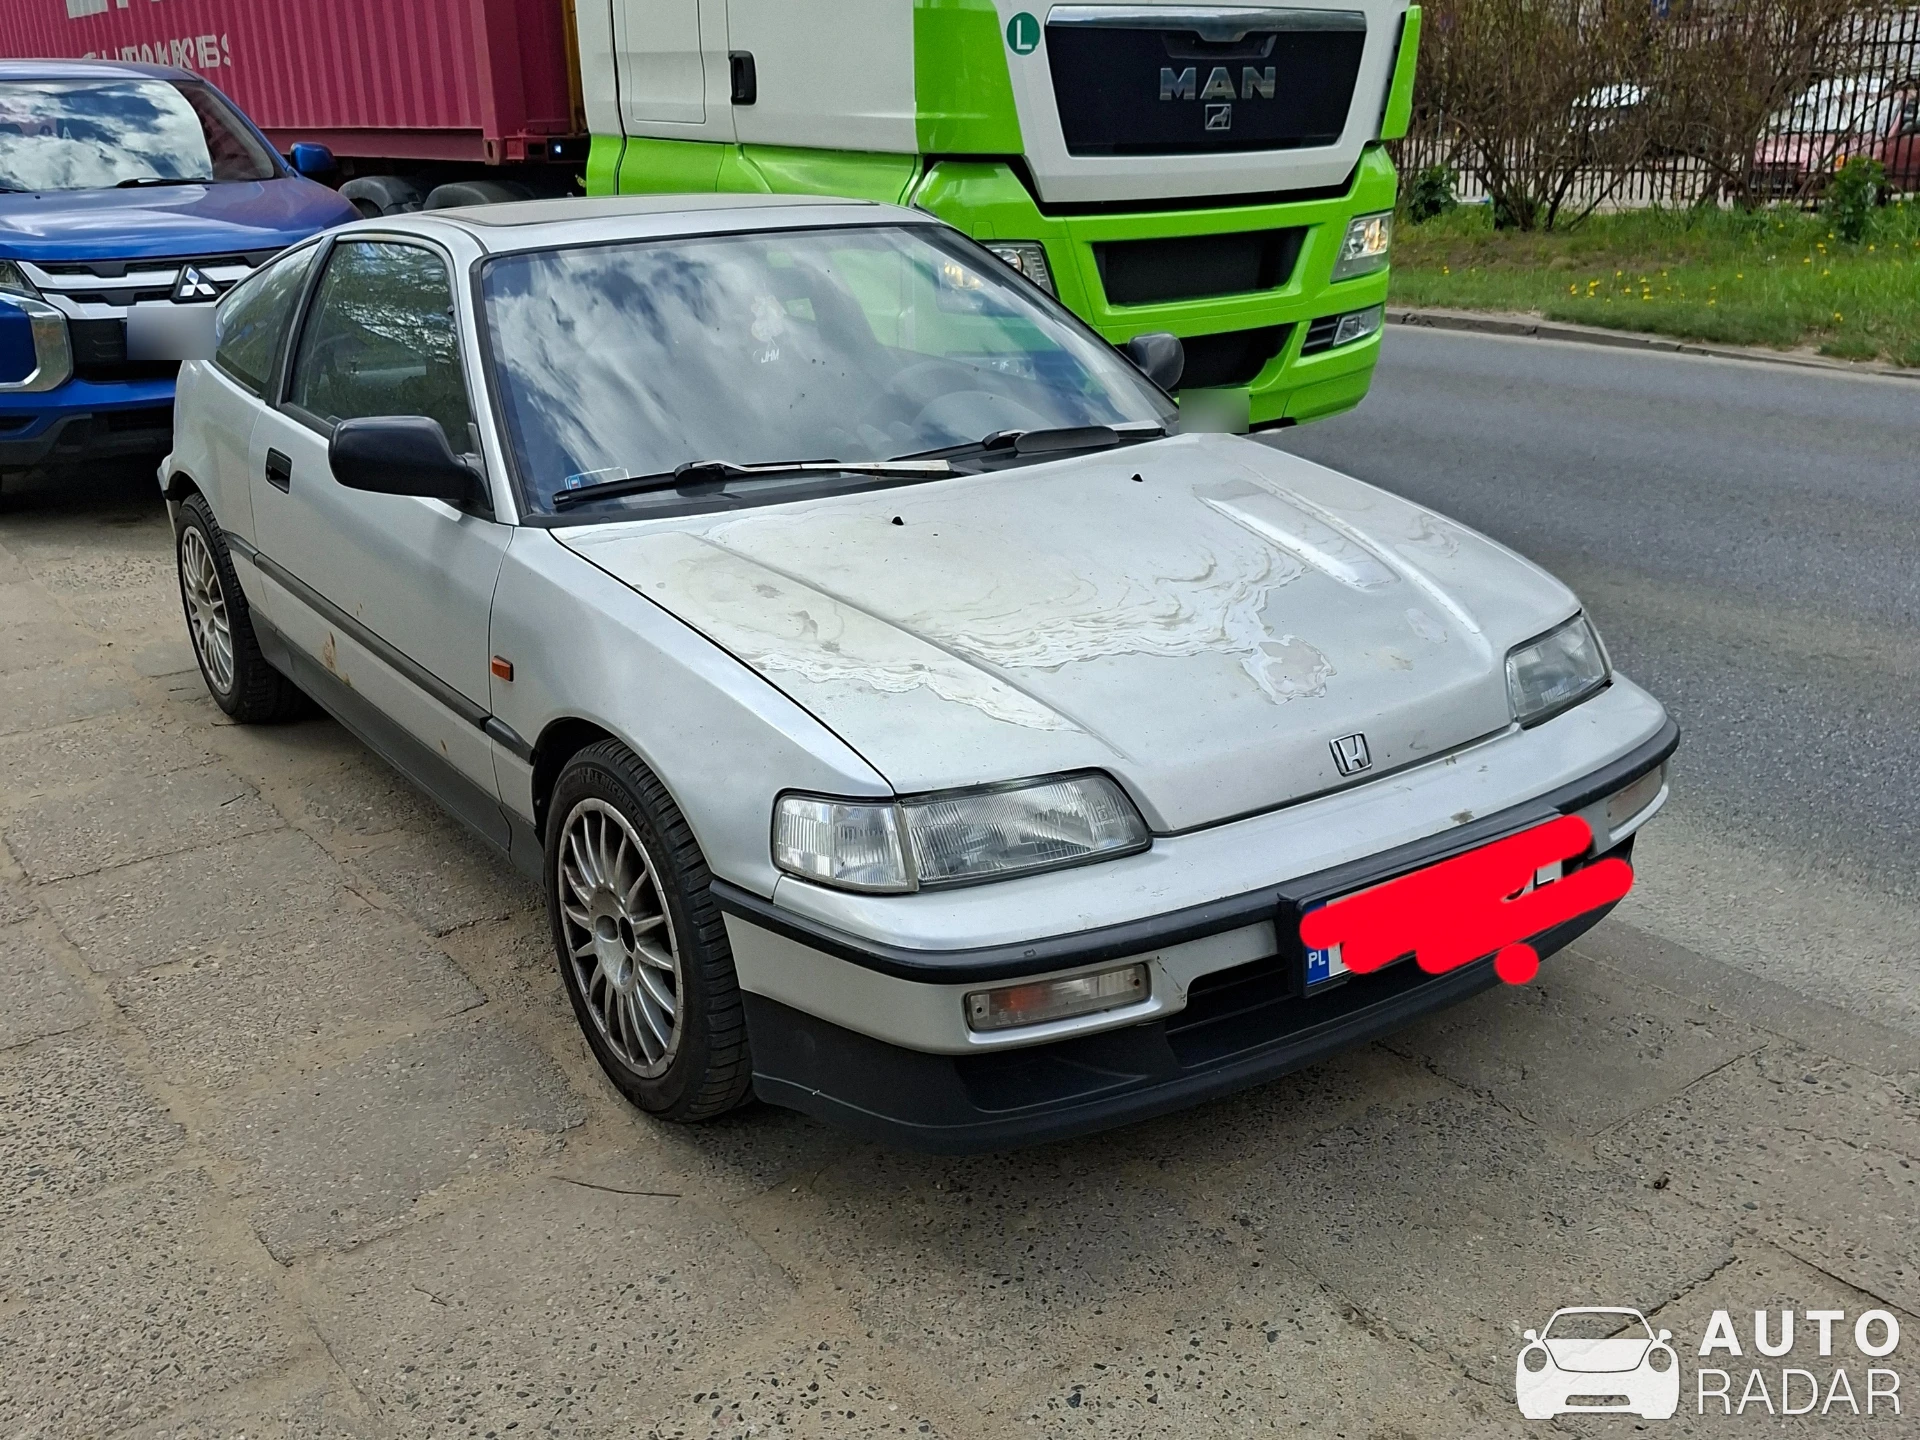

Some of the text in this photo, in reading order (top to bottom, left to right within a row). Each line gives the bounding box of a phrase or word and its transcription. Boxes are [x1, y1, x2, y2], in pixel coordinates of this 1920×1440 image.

[1016, 19, 1033, 50] L
[1159, 66, 1277, 100] MAN
[1308, 949, 1326, 970] PL
